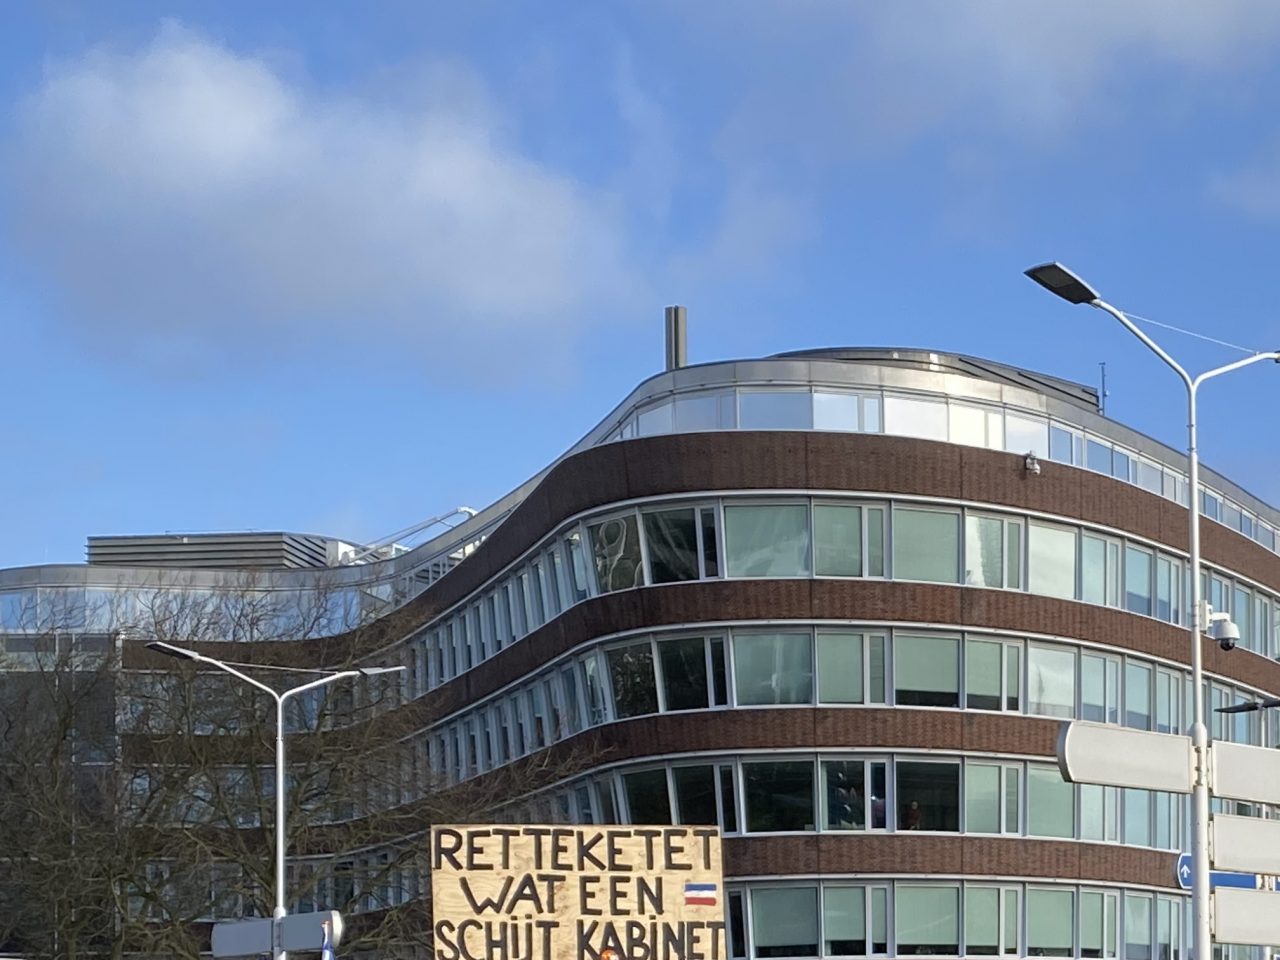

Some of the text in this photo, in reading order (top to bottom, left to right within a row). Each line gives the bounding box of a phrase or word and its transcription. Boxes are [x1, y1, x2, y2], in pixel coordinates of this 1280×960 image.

[434, 828, 718, 871] RETTEKETET
[460, 873, 664, 915] WAT EEN
